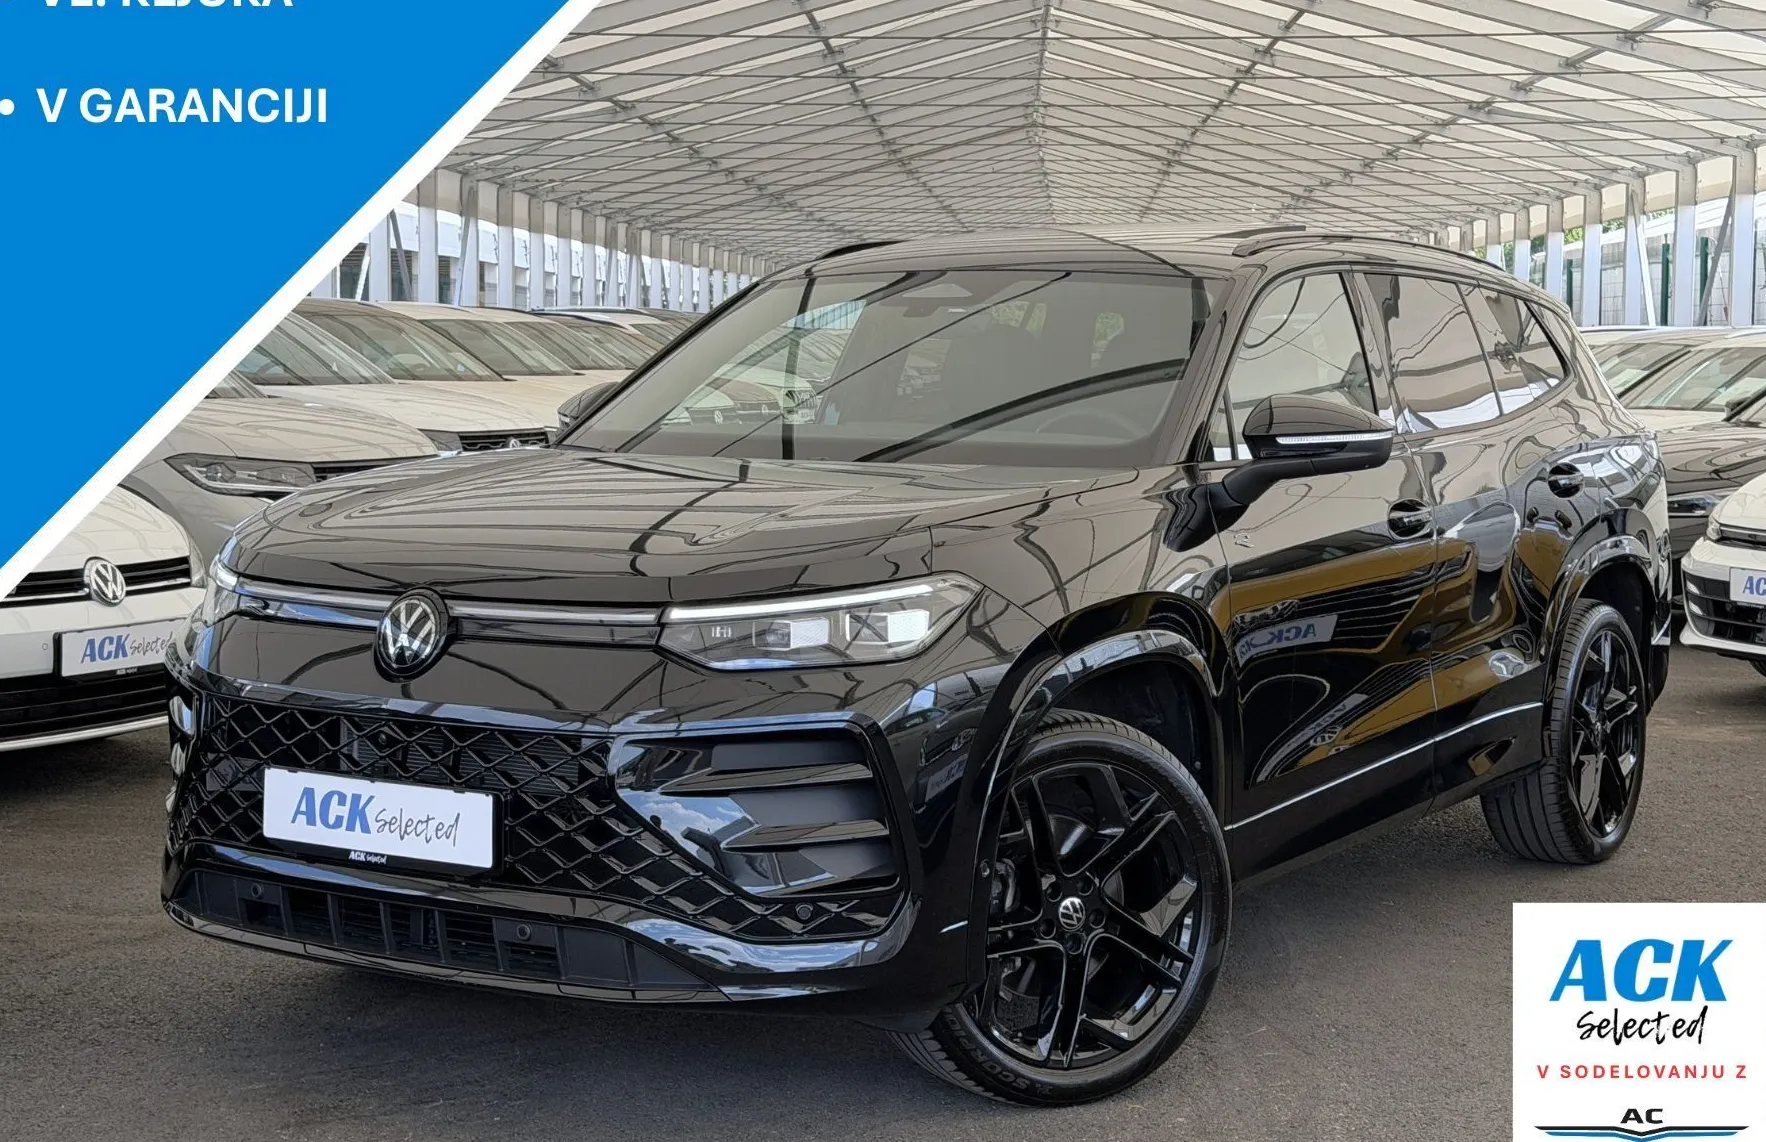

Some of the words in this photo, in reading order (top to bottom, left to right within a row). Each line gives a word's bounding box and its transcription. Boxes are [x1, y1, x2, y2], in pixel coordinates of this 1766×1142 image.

[81, 633, 131, 665] ACK
[291, 786, 376, 835] ACK
[374, 808, 461, 848] Selected
[348, 850, 367, 862] ACK
